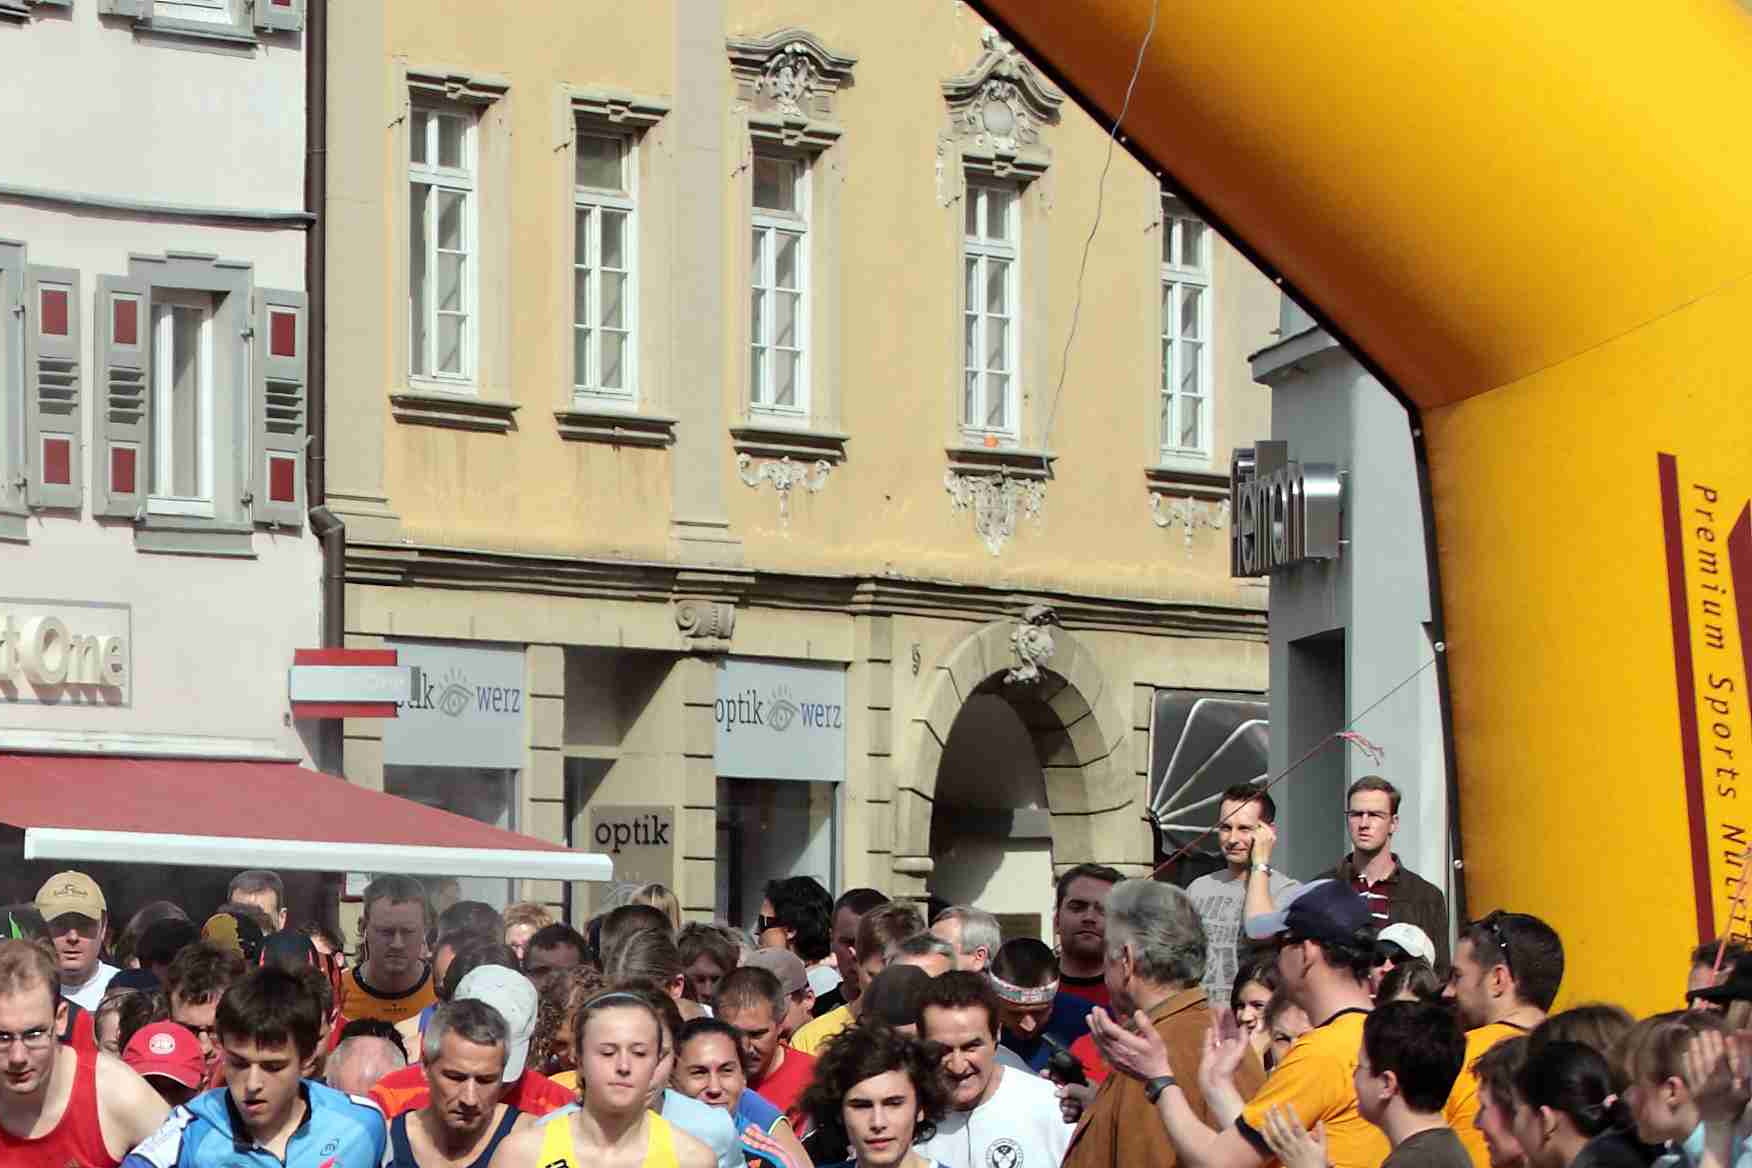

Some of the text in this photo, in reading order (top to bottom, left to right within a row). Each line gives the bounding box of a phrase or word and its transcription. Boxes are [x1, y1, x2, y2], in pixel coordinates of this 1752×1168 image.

[1693, 483, 1727, 650] Premium
[22, 615, 124, 688] One
[476, 686, 521, 713] werz
[714, 690, 842, 732] optik werz
[1704, 672, 1740, 800] Sports
[594, 815, 670, 854] optik
